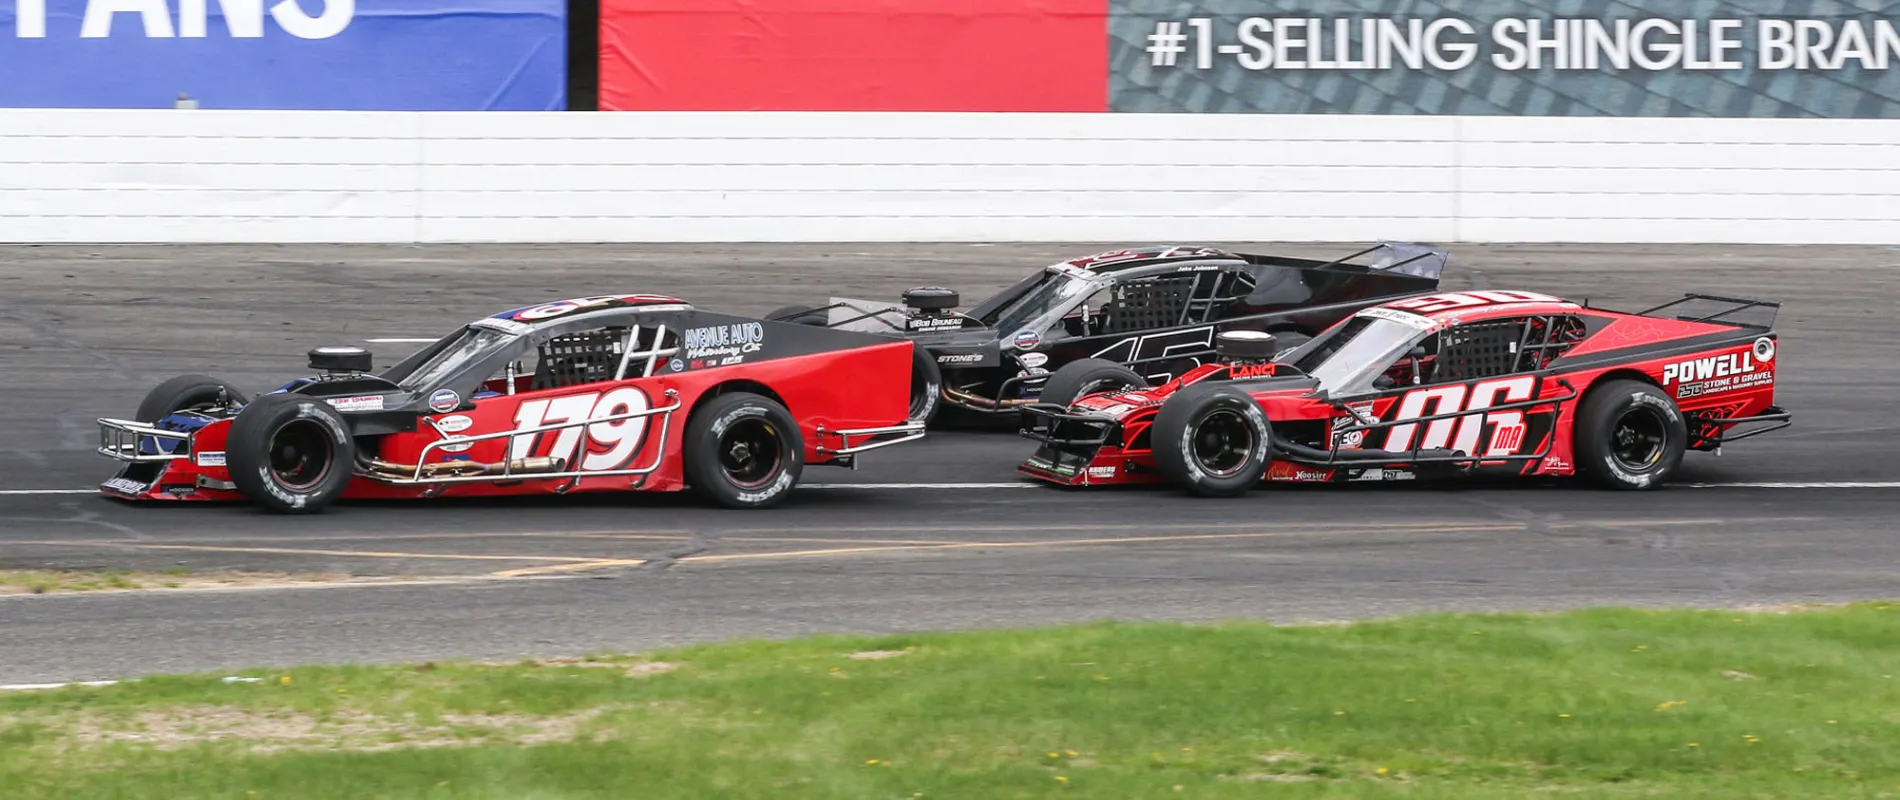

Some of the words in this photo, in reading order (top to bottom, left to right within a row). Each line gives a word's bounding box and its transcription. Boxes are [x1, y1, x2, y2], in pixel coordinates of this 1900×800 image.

[1146, 17, 1479, 70] #1-SELLING
[1491, 17, 1743, 71] SHINGLE
[685, 325, 729, 350] AVENUE
[730, 321, 764, 345] AUTO
[1229, 362, 1276, 378] LANCI
[1662, 351, 1756, 386] POWELL
[1703, 377, 1732, 389] STONE
[1741, 370, 1773, 383] GRAVEL
[510, 384, 653, 472] 179
[1382, 373, 1537, 465] 06
[1493, 426, 1519, 450] MA
